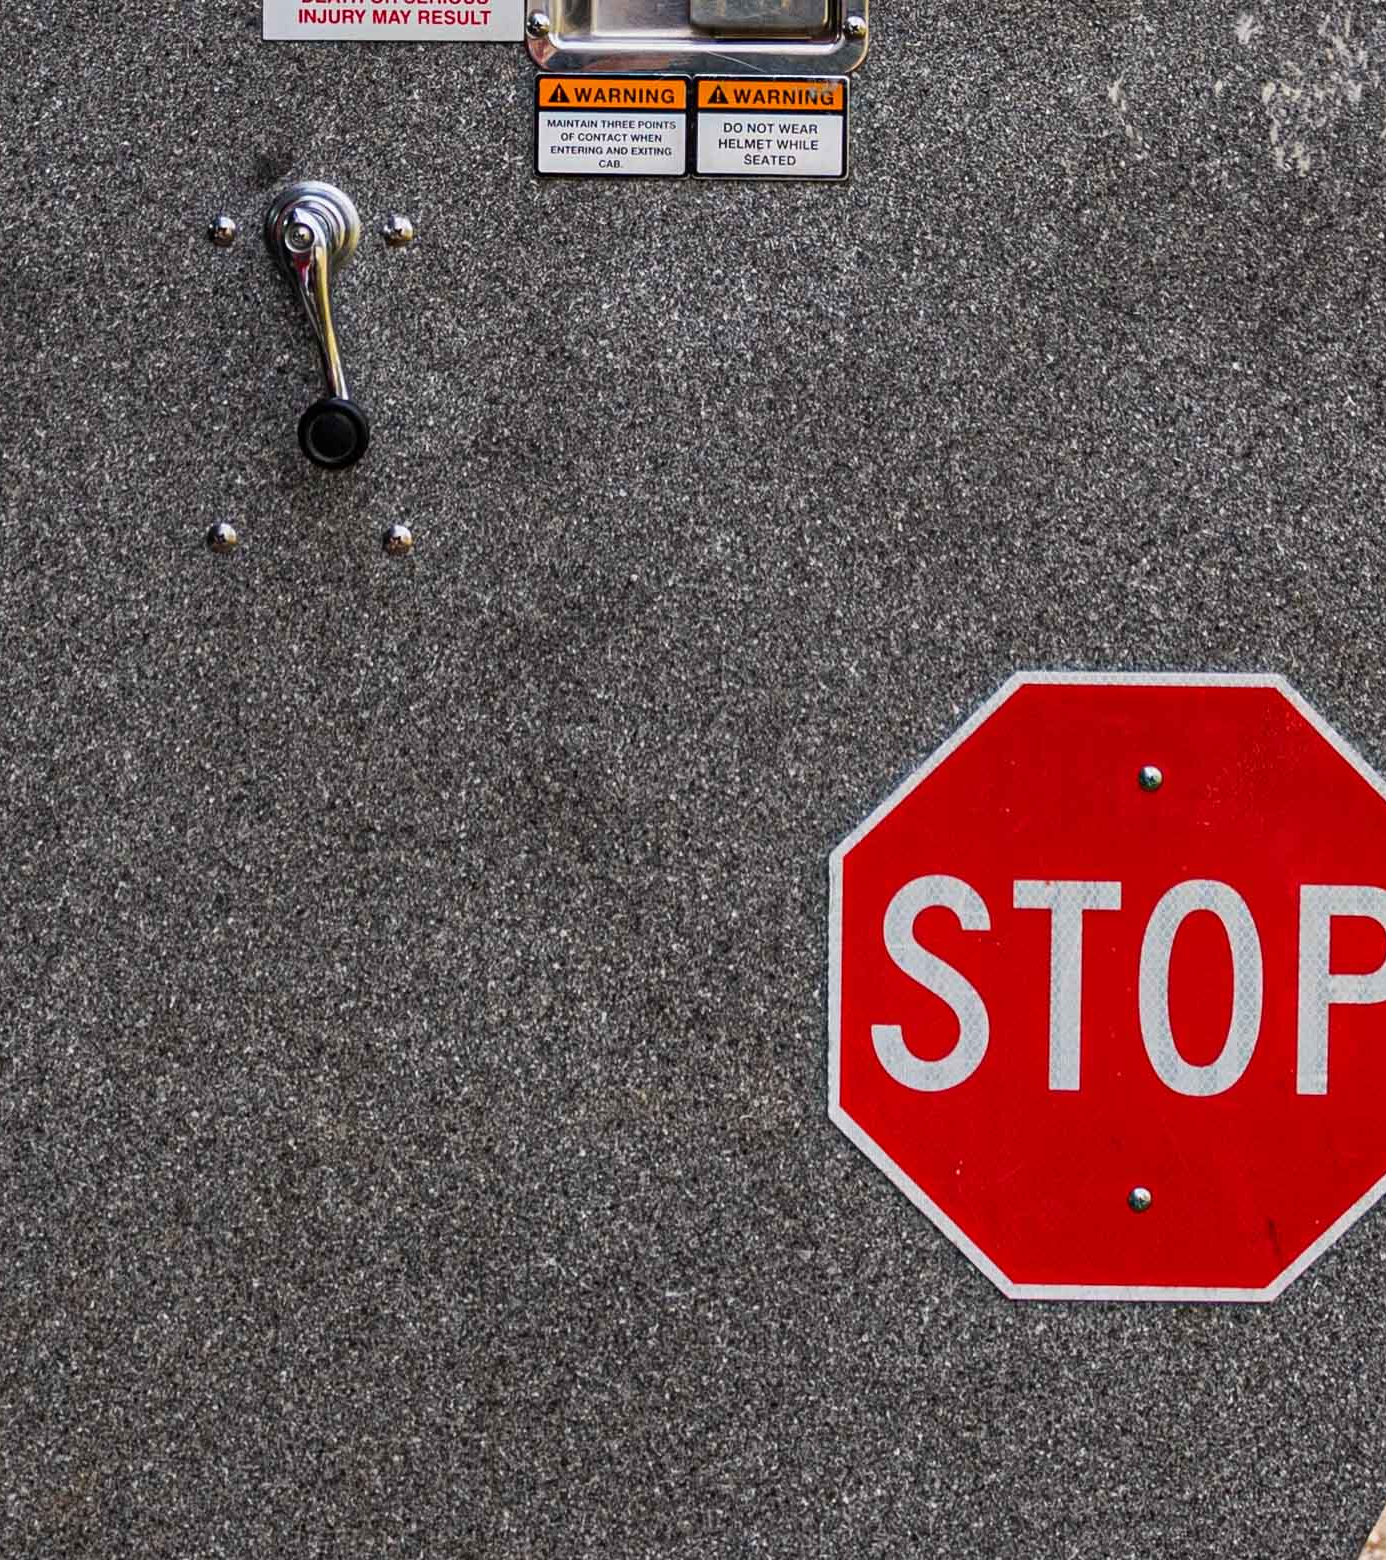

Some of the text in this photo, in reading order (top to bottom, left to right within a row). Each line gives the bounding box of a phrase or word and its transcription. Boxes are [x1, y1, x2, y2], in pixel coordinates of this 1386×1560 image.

[298, 9, 492, 25] INJURY MAY RESULT
[574, 88, 675, 103] WARNING
[733, 89, 834, 105] WARNING
[547, 120, 676, 129] MAINTAIN THREE POINTS
[723, 123, 818, 134] DO NOT WEAR
[561, 133, 662, 142] OF CONTACT WHEN
[718, 139, 819, 150] HELMET WHILE
[550, 146, 672, 155] ENTERING AND EXITING
[599, 160, 623, 168] CAB.
[744, 155, 796, 165] SEATED
